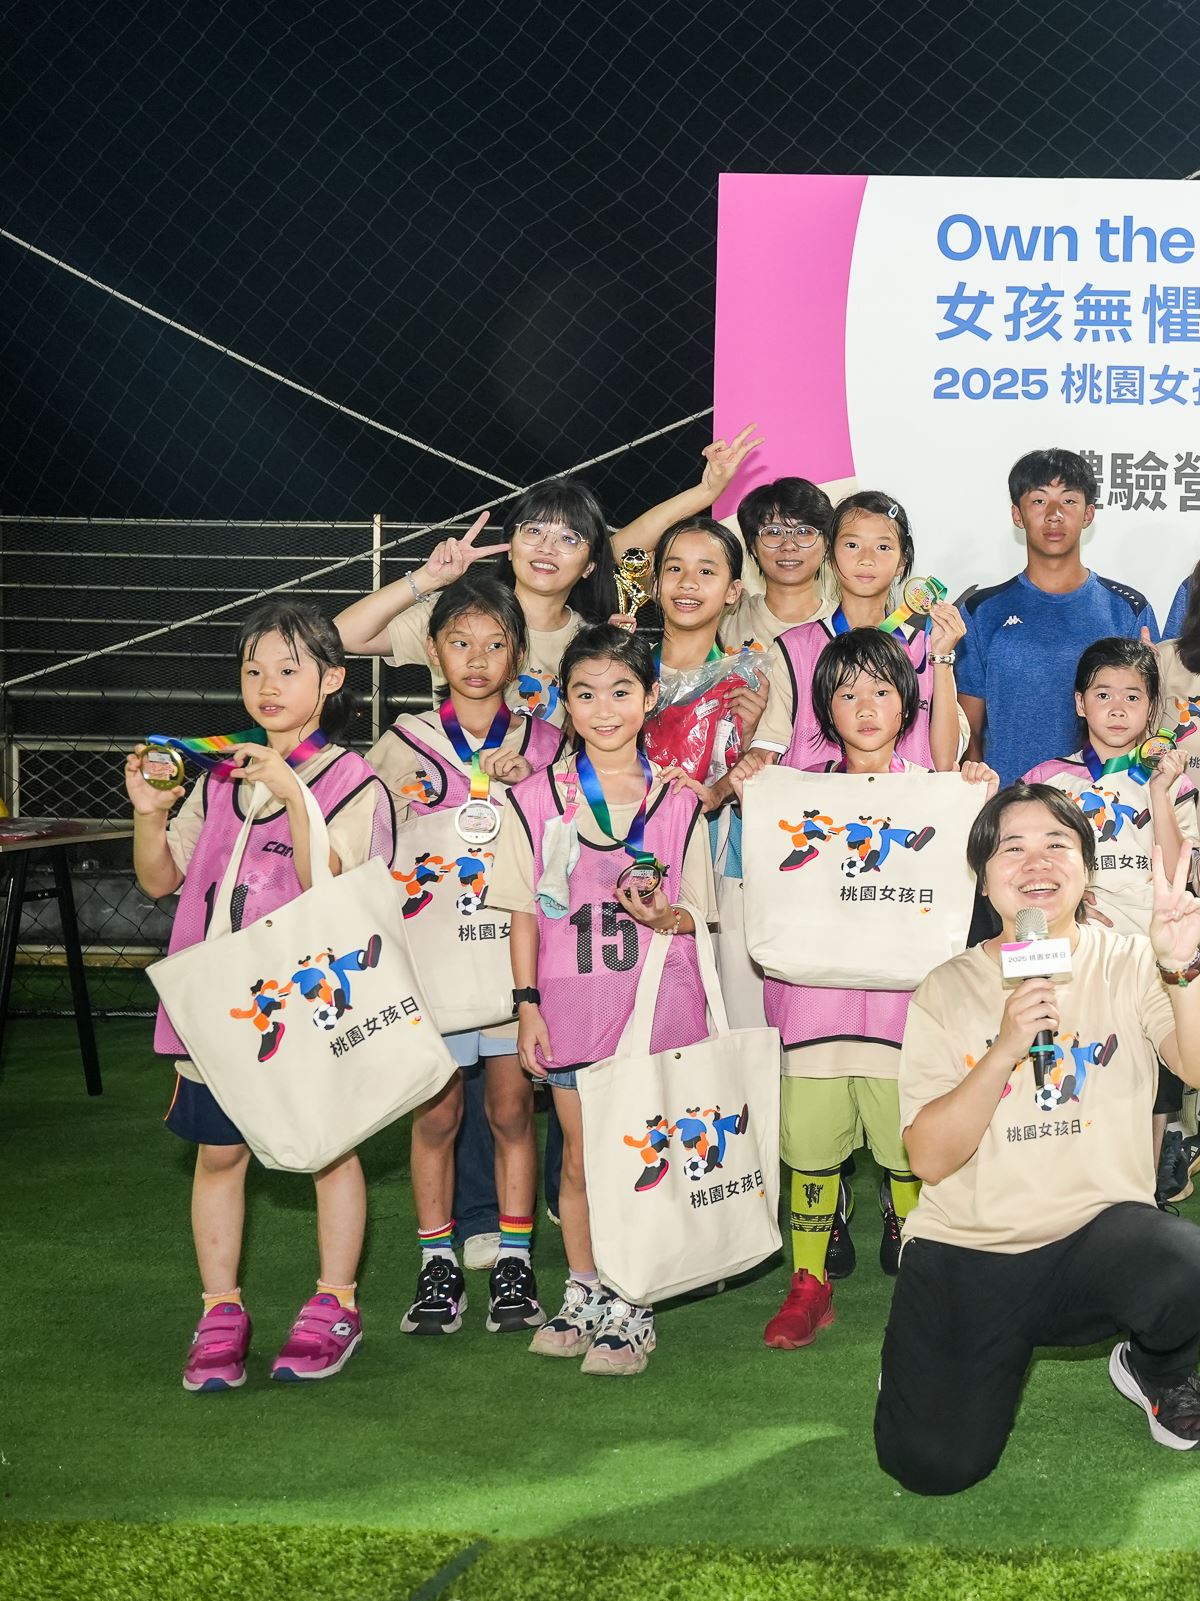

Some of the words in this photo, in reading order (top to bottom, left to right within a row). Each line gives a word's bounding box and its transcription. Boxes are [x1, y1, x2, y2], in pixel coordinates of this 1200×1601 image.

[937, 213, 1078, 262] Own
[1095, 215, 1195, 264] the
[933, 367, 1049, 401] 2025
[1092, 853, 1153, 872] 園女孩
[839, 885, 934, 904] 桃園女孩日
[570, 901, 639, 974] 15
[329, 996, 421, 1058] 桃園女孩日
[1006, 1119, 1082, 1143] 桃園女孩日
[690, 1169, 763, 1209] 桃園女孩日
